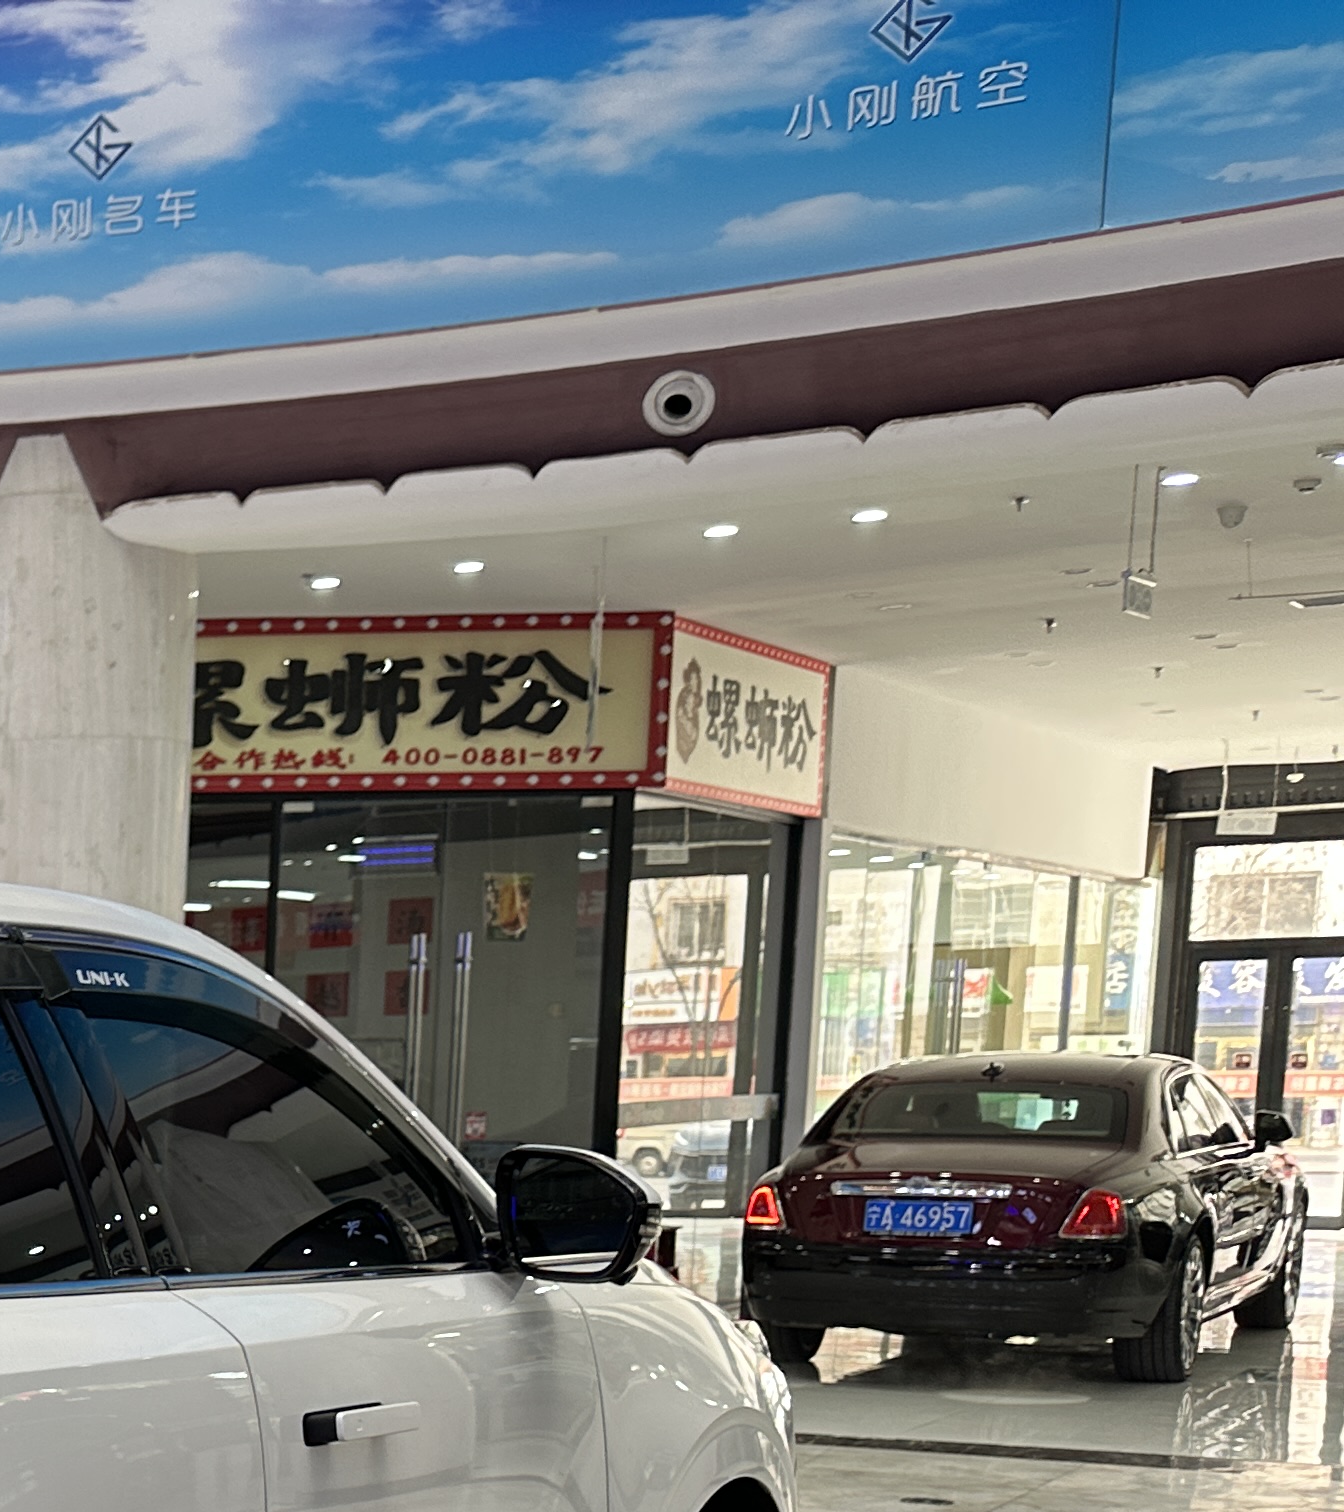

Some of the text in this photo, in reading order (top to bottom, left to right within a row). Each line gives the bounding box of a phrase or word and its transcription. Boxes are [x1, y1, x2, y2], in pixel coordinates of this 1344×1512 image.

[784, 59, 1028, 140] 小刚航空
[0, 187, 197, 246] 小刚名车
[705, 674, 817, 774] 螺蛳粉
[381, 747, 605, 766] 400-0881-897
[75, 969, 130, 988] UNI-K
